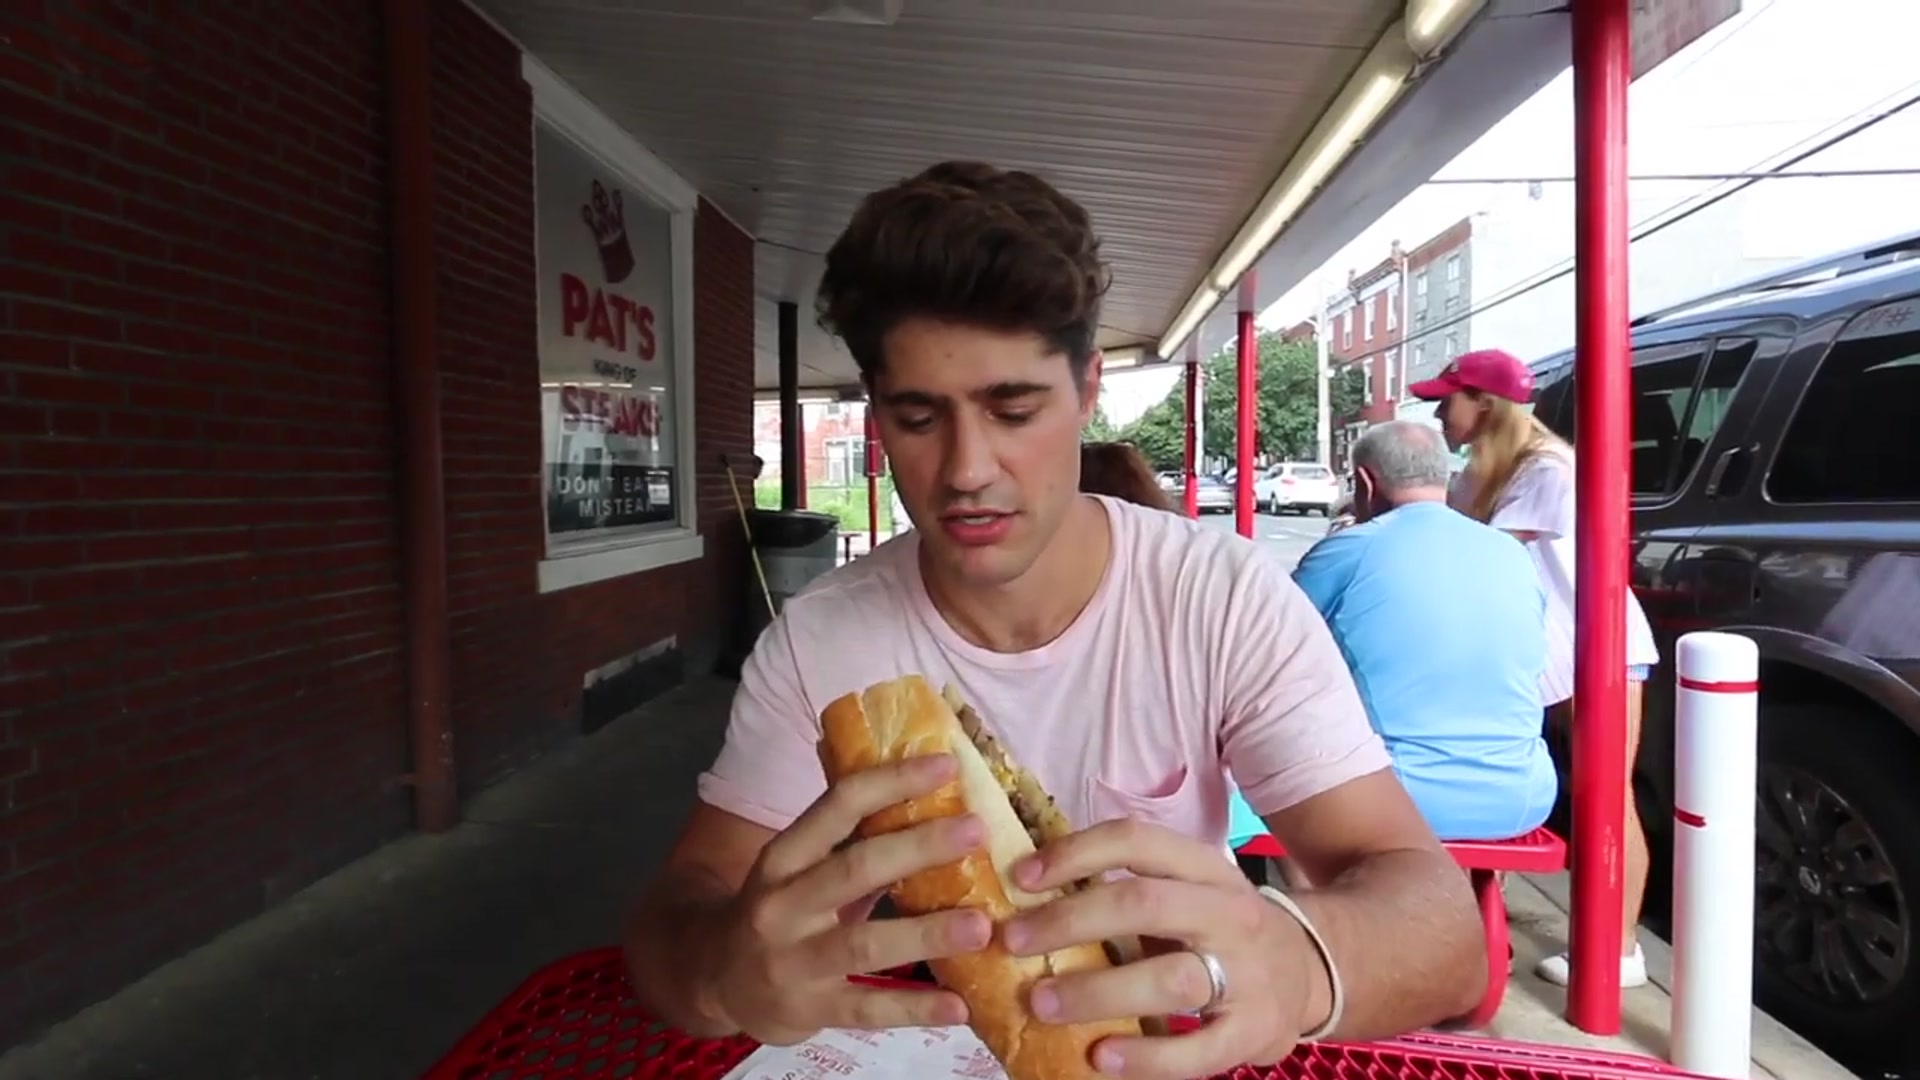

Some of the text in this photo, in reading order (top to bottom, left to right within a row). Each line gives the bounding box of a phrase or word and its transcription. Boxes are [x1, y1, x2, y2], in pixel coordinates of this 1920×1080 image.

[560, 272, 656, 360] PAT'S
[593, 359, 637, 382] KING OF
